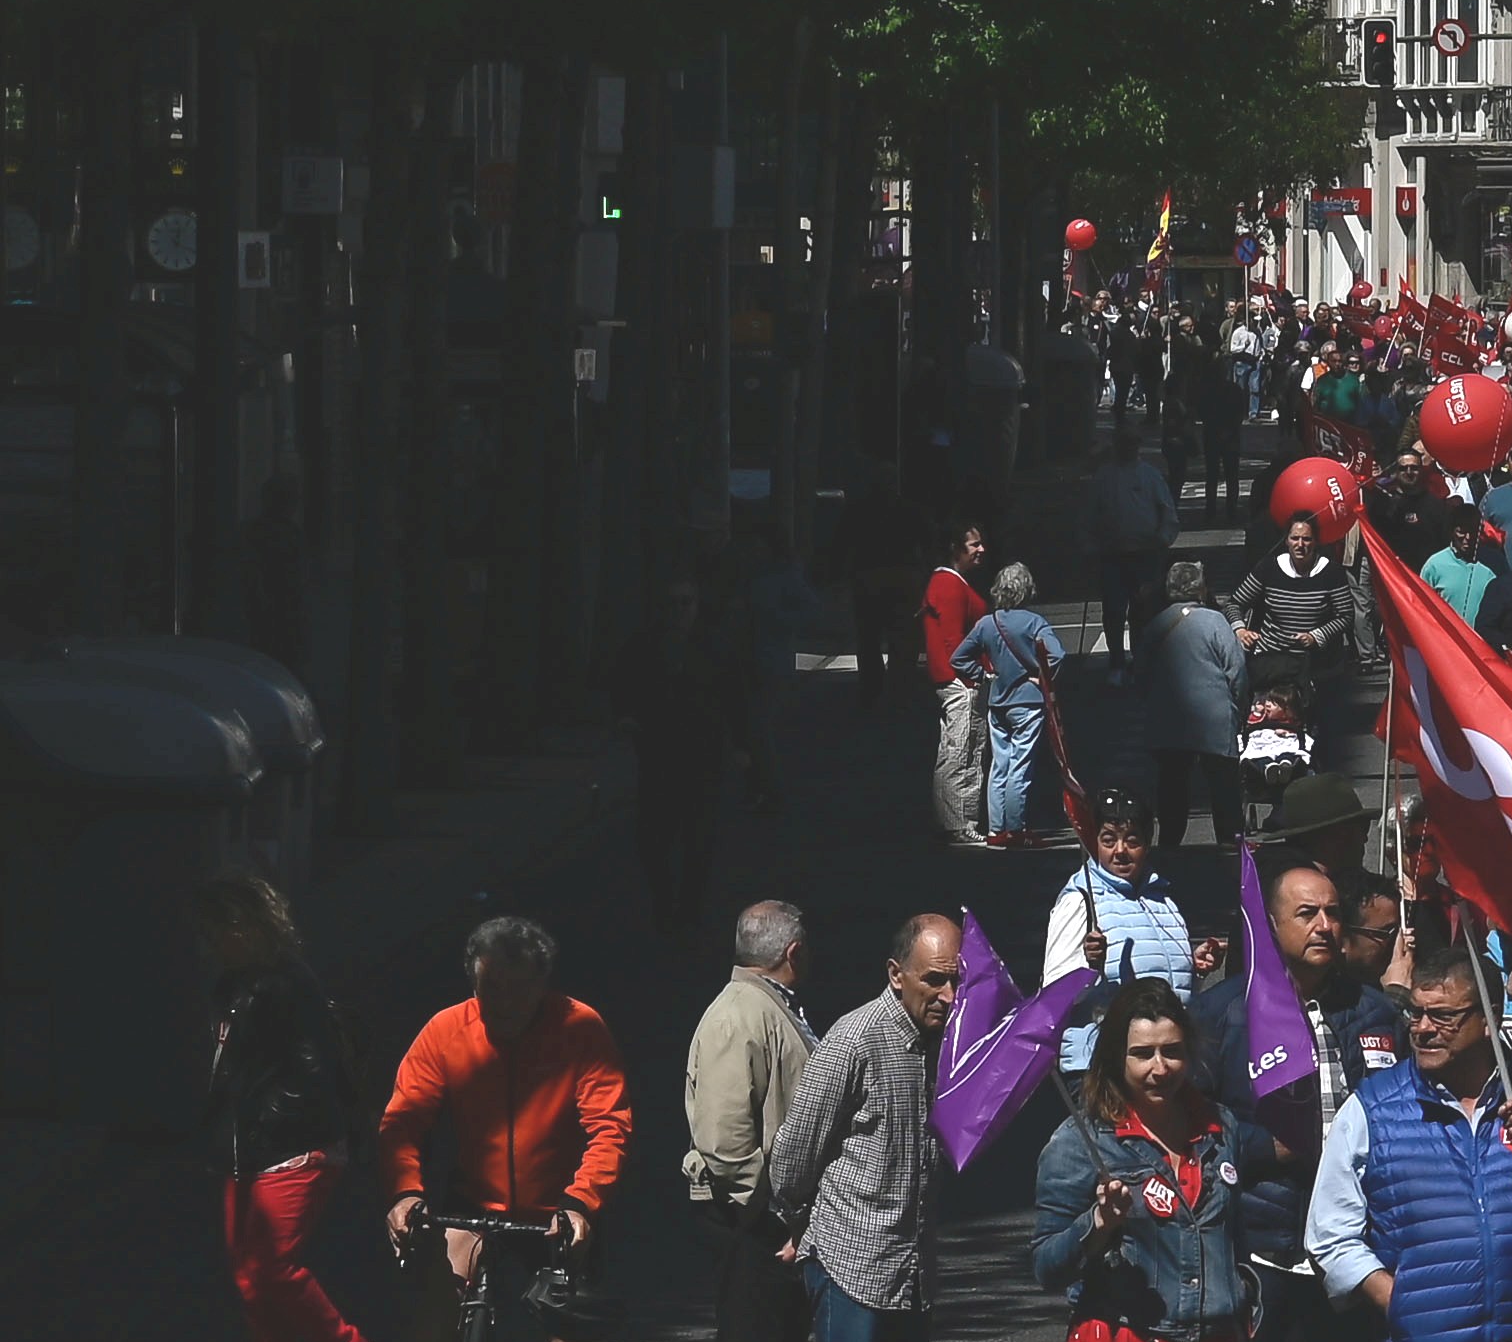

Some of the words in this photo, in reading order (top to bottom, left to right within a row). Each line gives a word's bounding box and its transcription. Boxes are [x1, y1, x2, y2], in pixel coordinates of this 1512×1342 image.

[1451, 378, 1465, 401] UGT
[1328, 478, 1343, 501] UGT
[1360, 1036, 1381, 1048] UGT
[1143, 1177, 1175, 1206] UGT
